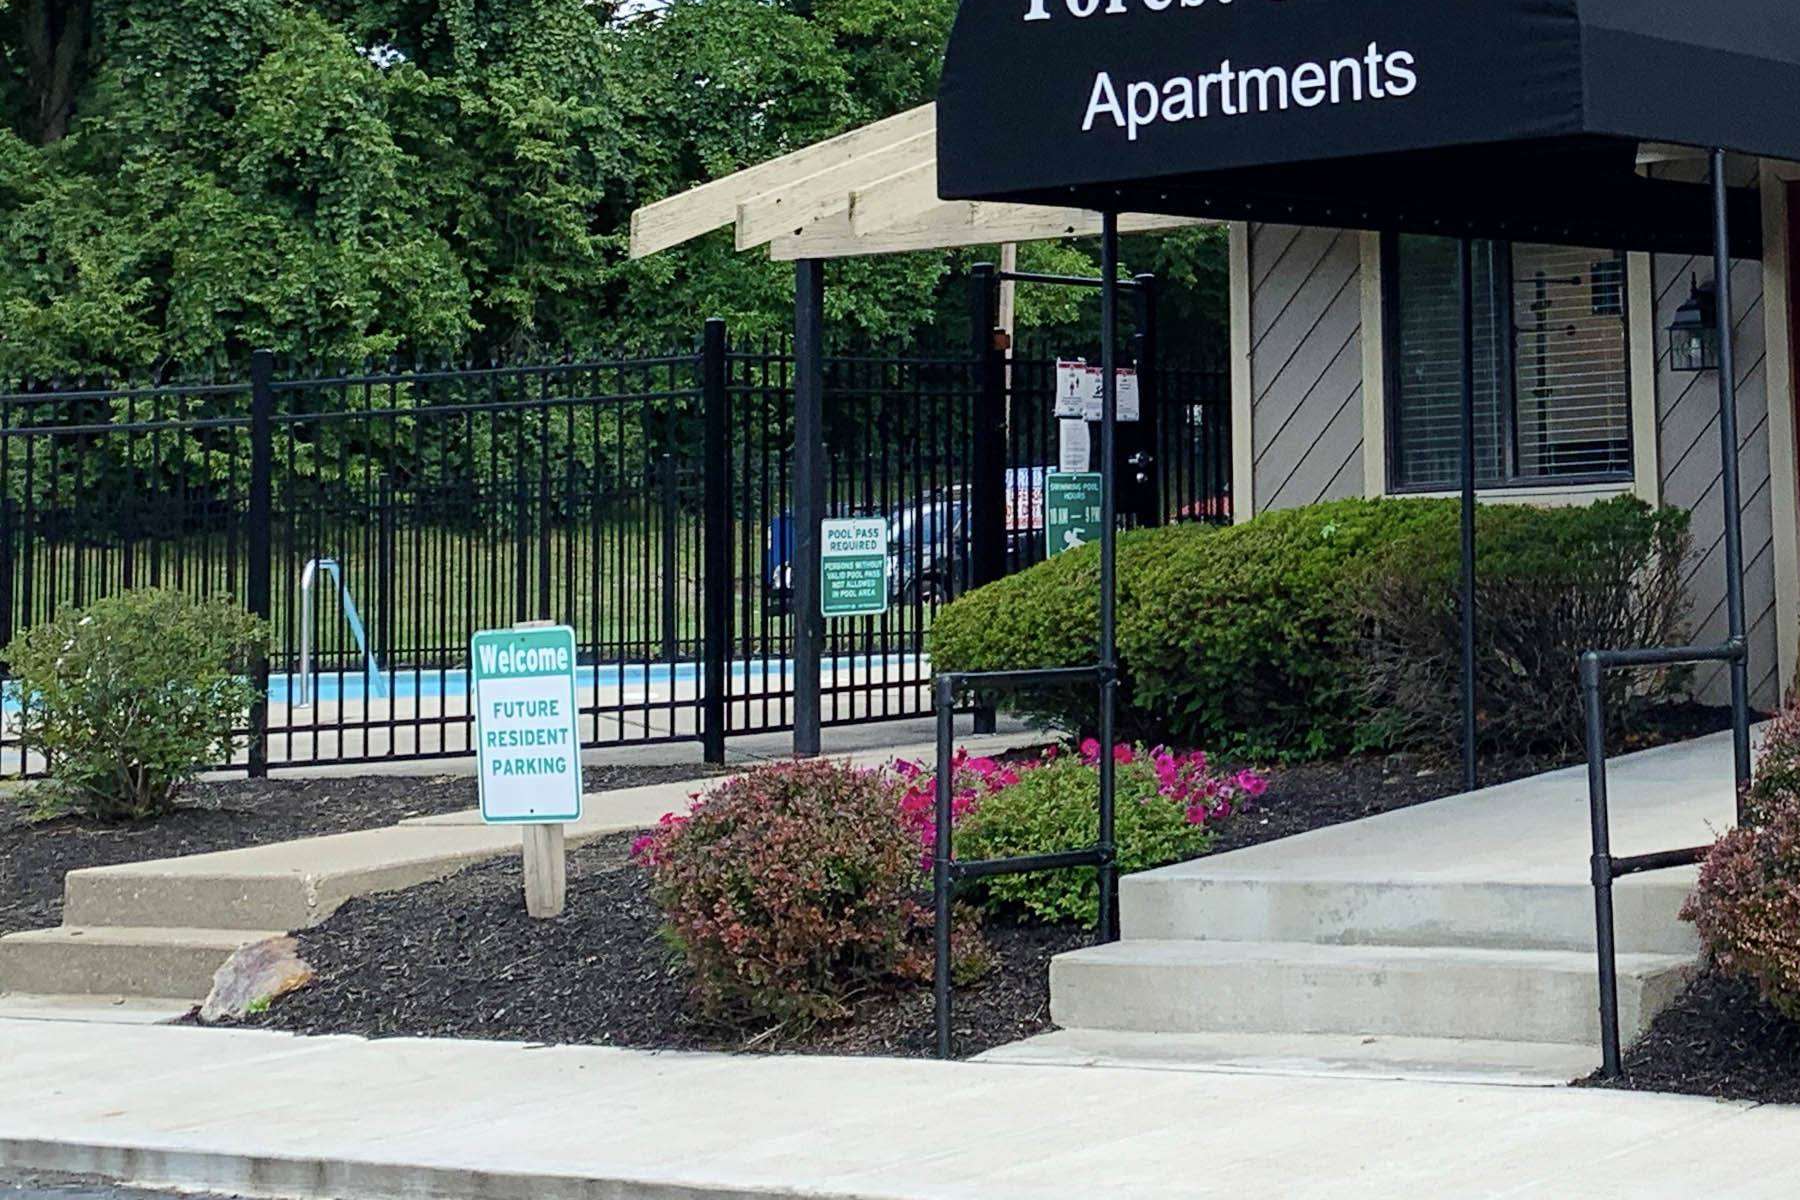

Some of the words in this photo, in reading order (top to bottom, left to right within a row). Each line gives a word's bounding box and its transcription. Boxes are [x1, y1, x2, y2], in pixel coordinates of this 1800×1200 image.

[1081, 41, 1417, 140] Apartments
[1083, 482, 1099, 491] POOL
[1064, 492, 1085, 500] HOURS
[828, 529, 852, 540] POOL
[855, 527, 879, 538] PASS
[830, 540, 878, 551] REQUIRED
[824, 561, 854, 570] PERSONS
[855, 560, 883, 569] WITHOUT
[826, 571, 846, 580] VALID
[847, 570, 863, 579] POOL
[864, 569, 881, 578] PASS
[832, 580, 845, 588] NOT
[846, 579, 876, 588] ALLOWED
[832, 589, 839, 598] IN
[840, 589, 857, 598] POOL
[858, 588, 876, 597] AREA
[479, 643, 568, 675] Welcome
[493, 700, 559, 718] FUTURE
[487, 728, 568, 748] RESIDENT
[492, 757, 566, 776] PARKING
